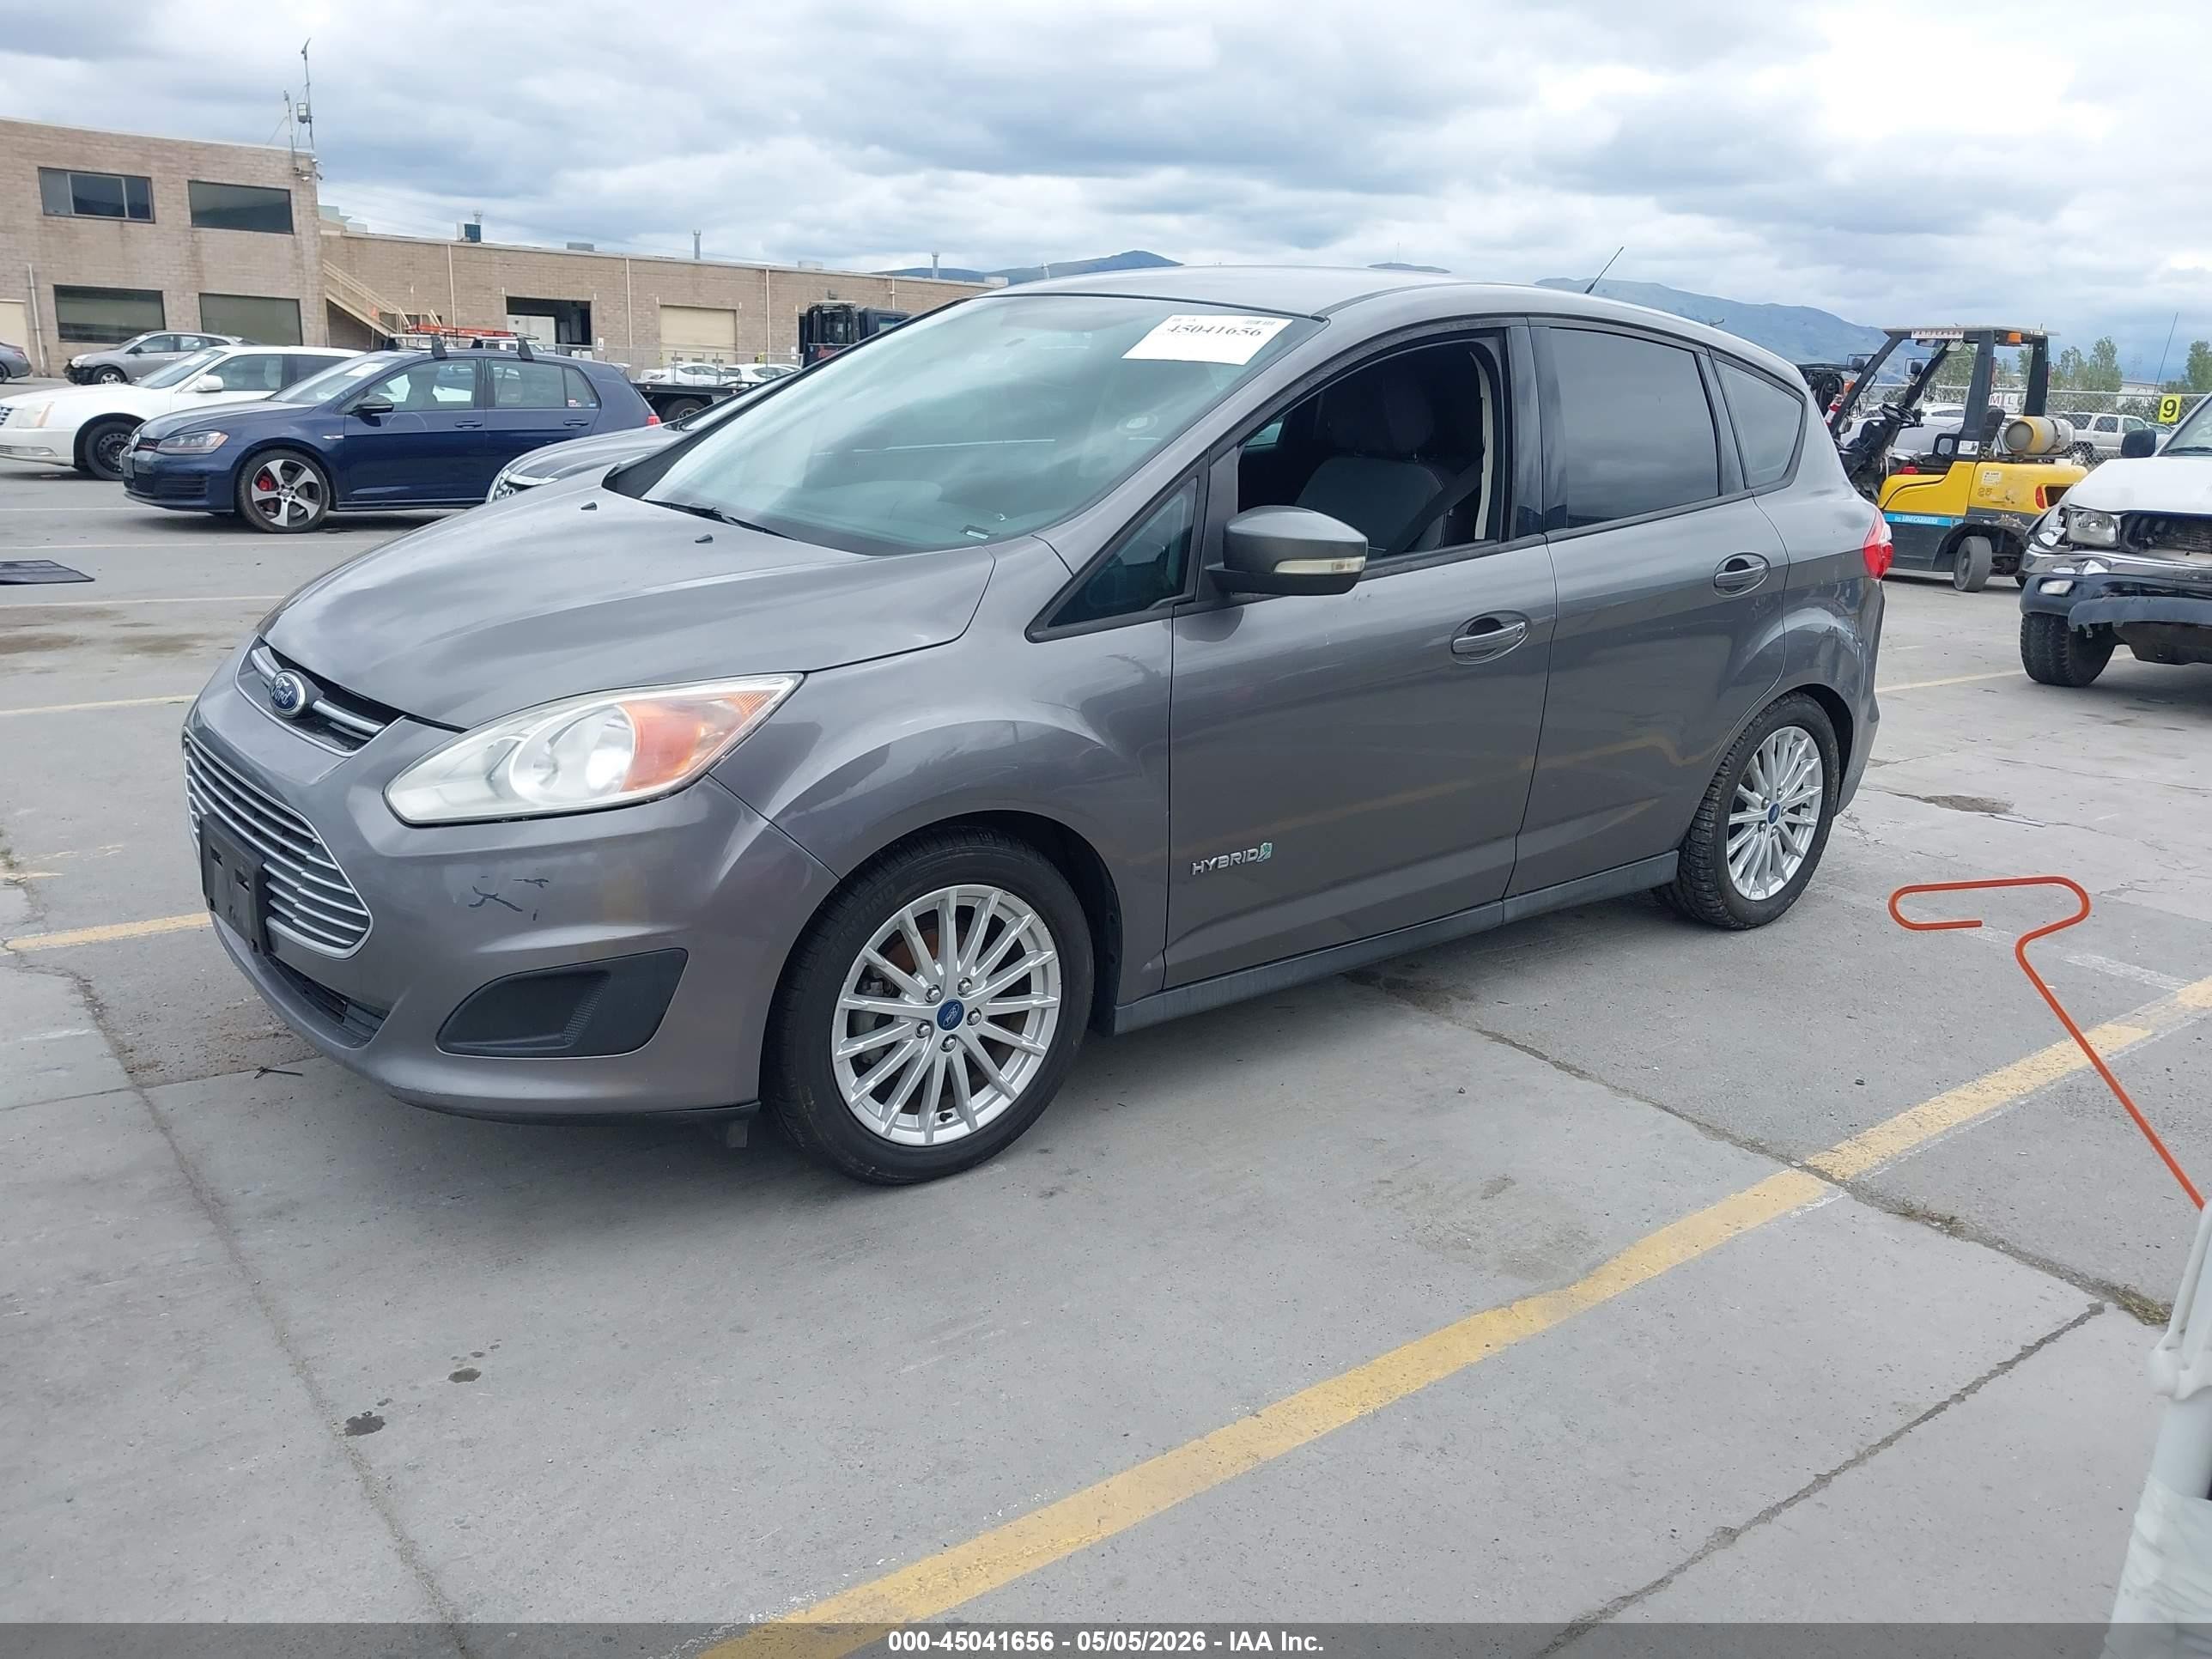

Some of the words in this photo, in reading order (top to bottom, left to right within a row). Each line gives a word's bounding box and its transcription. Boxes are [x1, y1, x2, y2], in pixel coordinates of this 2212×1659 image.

[1168, 324, 1262, 337] 45041656
[2162, 398, 2178, 418] 9
[270, 677, 293, 706] Ford
[1190, 848, 1260, 876] HYBRID
